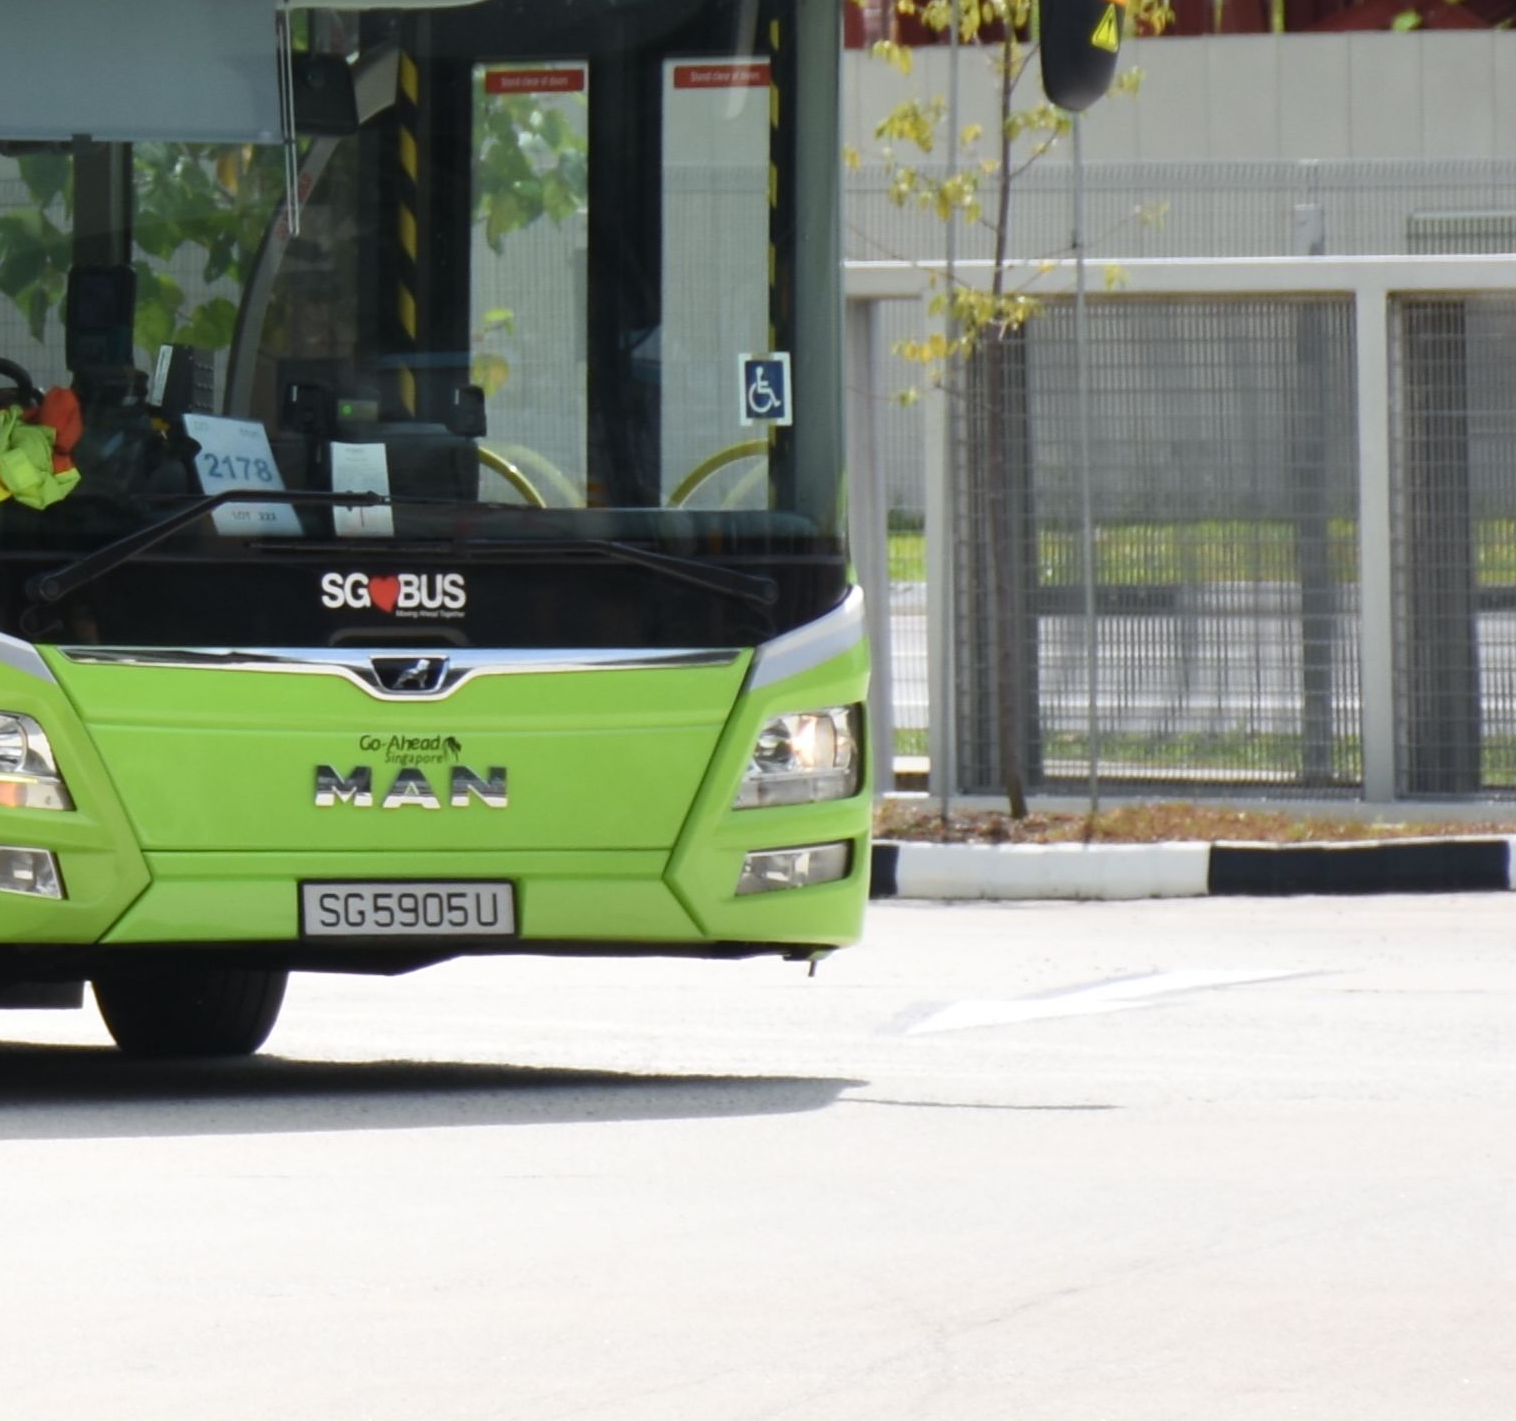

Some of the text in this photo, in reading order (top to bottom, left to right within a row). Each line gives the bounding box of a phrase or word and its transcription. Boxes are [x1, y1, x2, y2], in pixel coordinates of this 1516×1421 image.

[204, 453, 273, 483] 2178
[359, 735, 441, 752] Go-Ahead
[384, 751, 445, 766] Singapore
[315, 765, 508, 809] MAN
[319, 892, 499, 927] SG5905U
